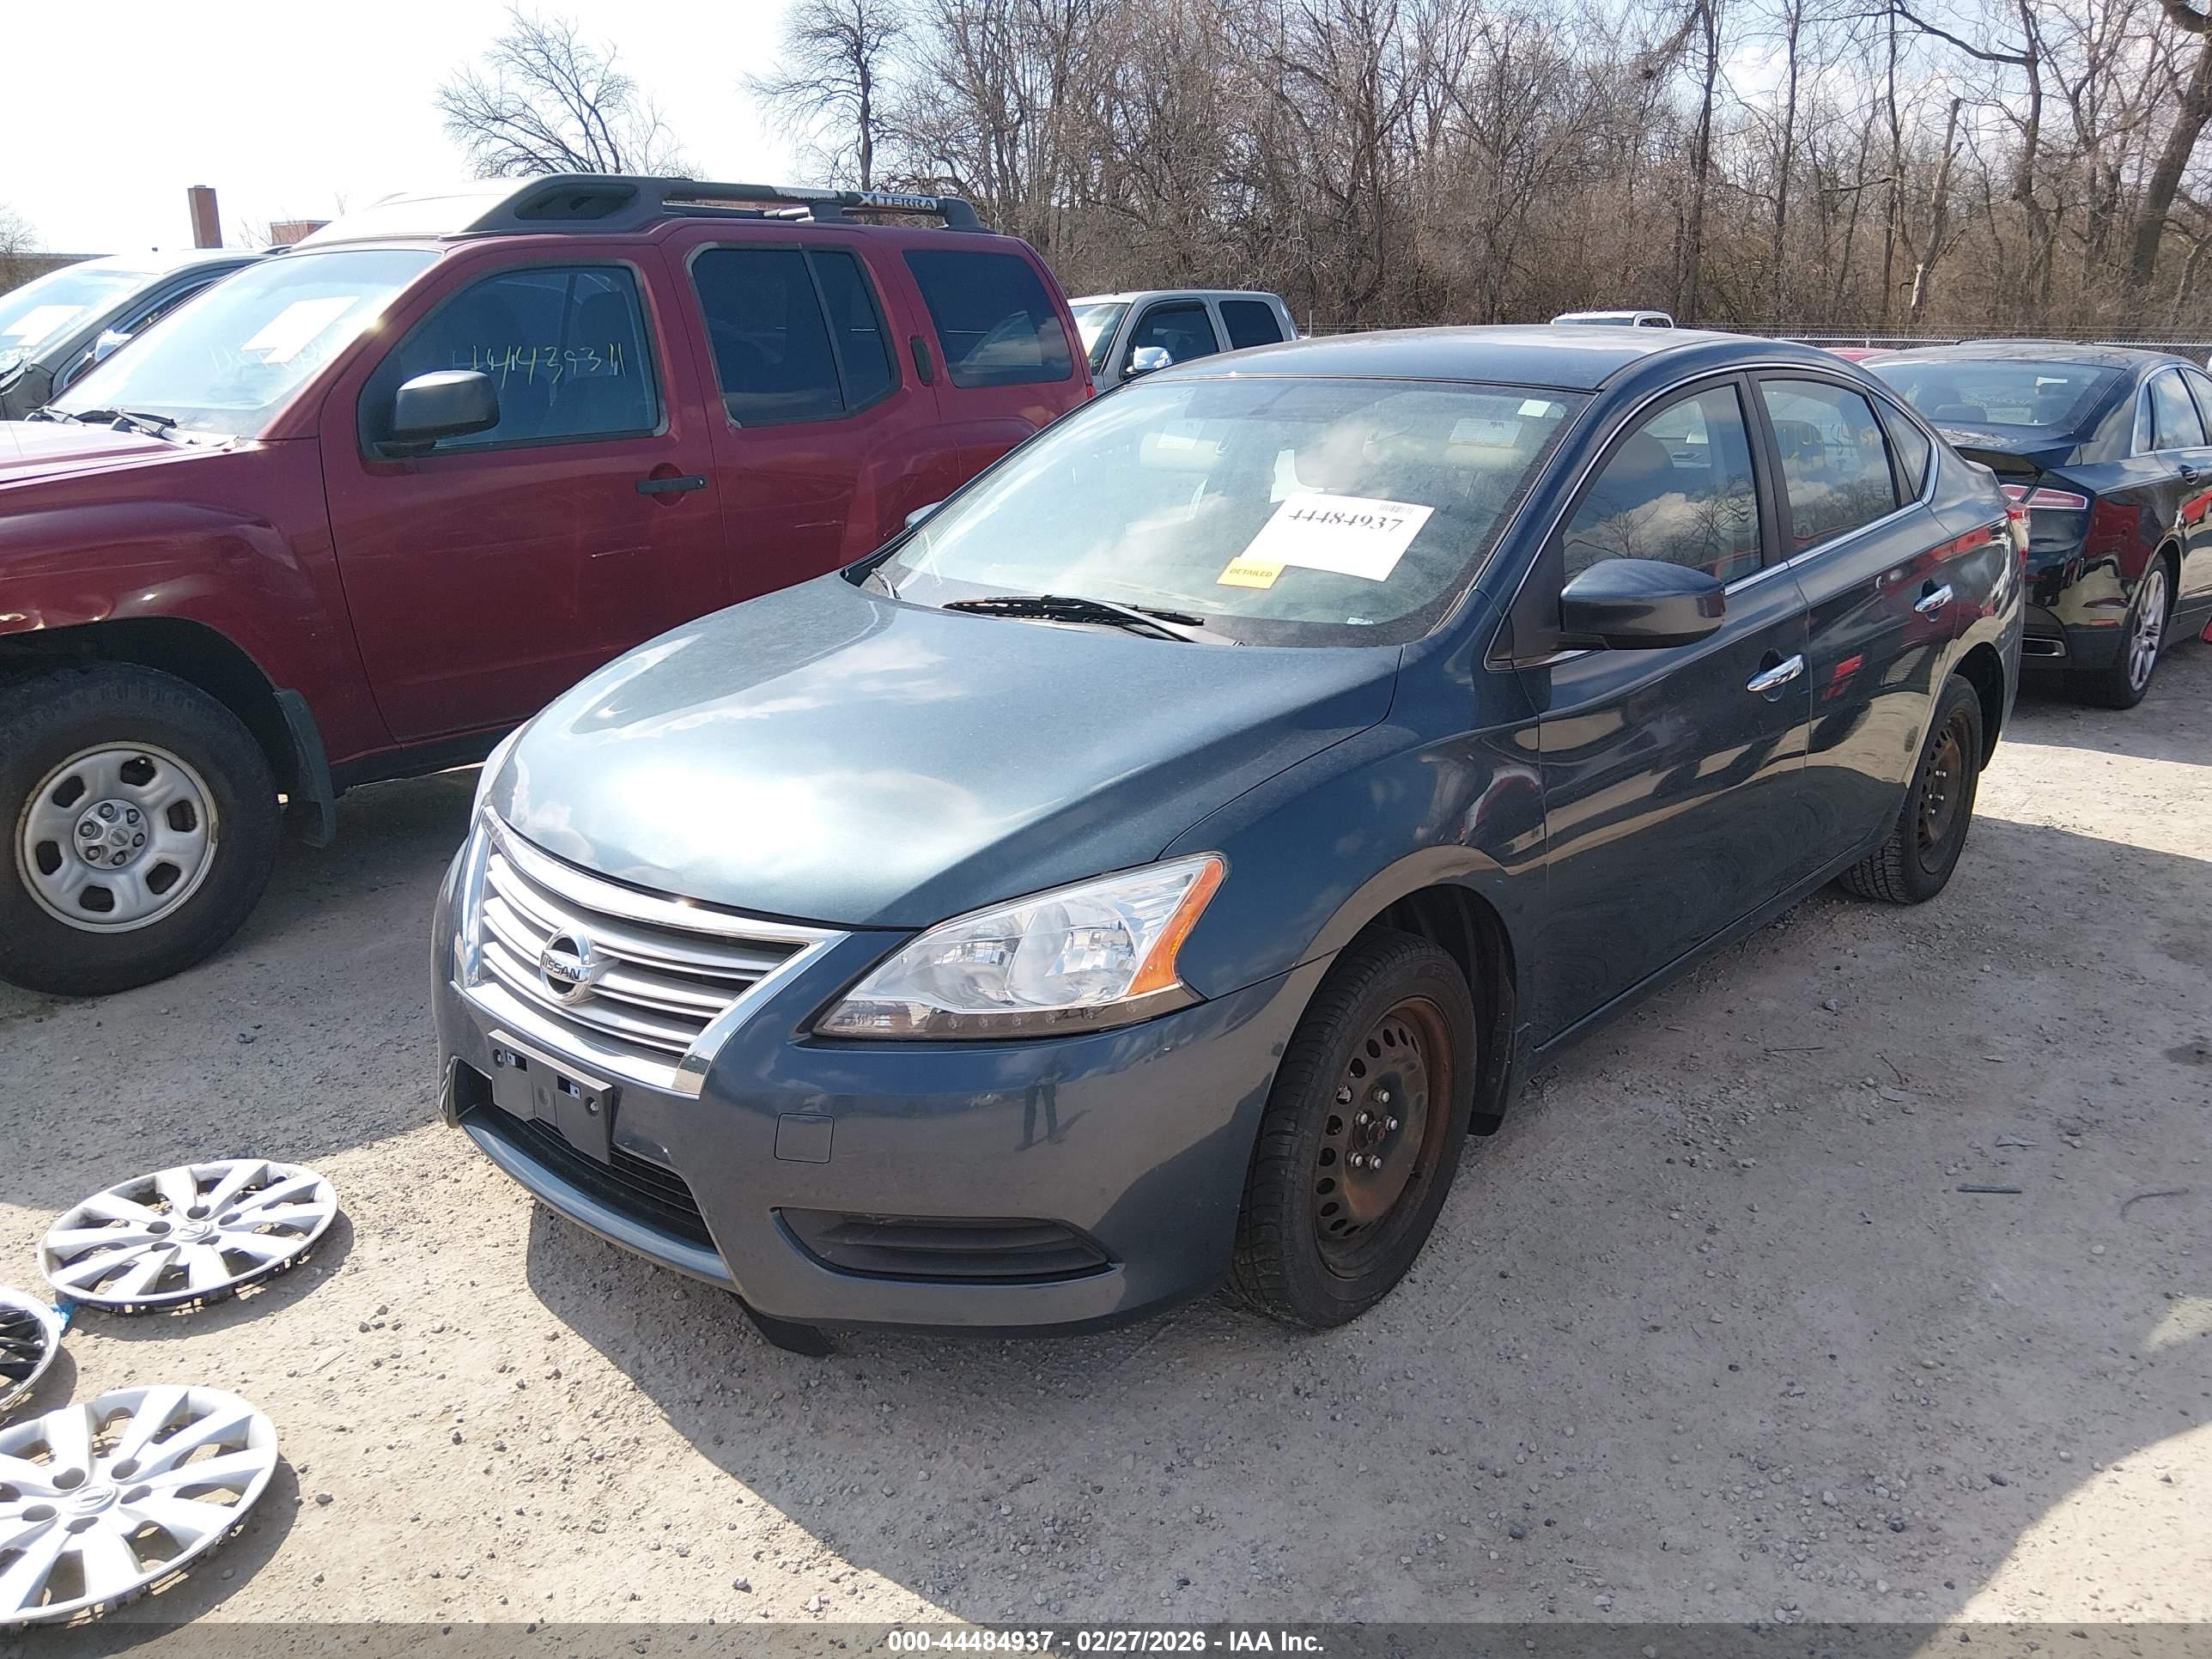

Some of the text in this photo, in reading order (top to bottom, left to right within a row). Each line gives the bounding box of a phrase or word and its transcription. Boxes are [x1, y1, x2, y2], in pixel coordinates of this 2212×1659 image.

[859, 193, 936, 211] XTERRA
[1289, 509, 1404, 532] 44484937
[1230, 568, 1273, 577] DETAILED
[542, 951, 581, 981] NISSAN
